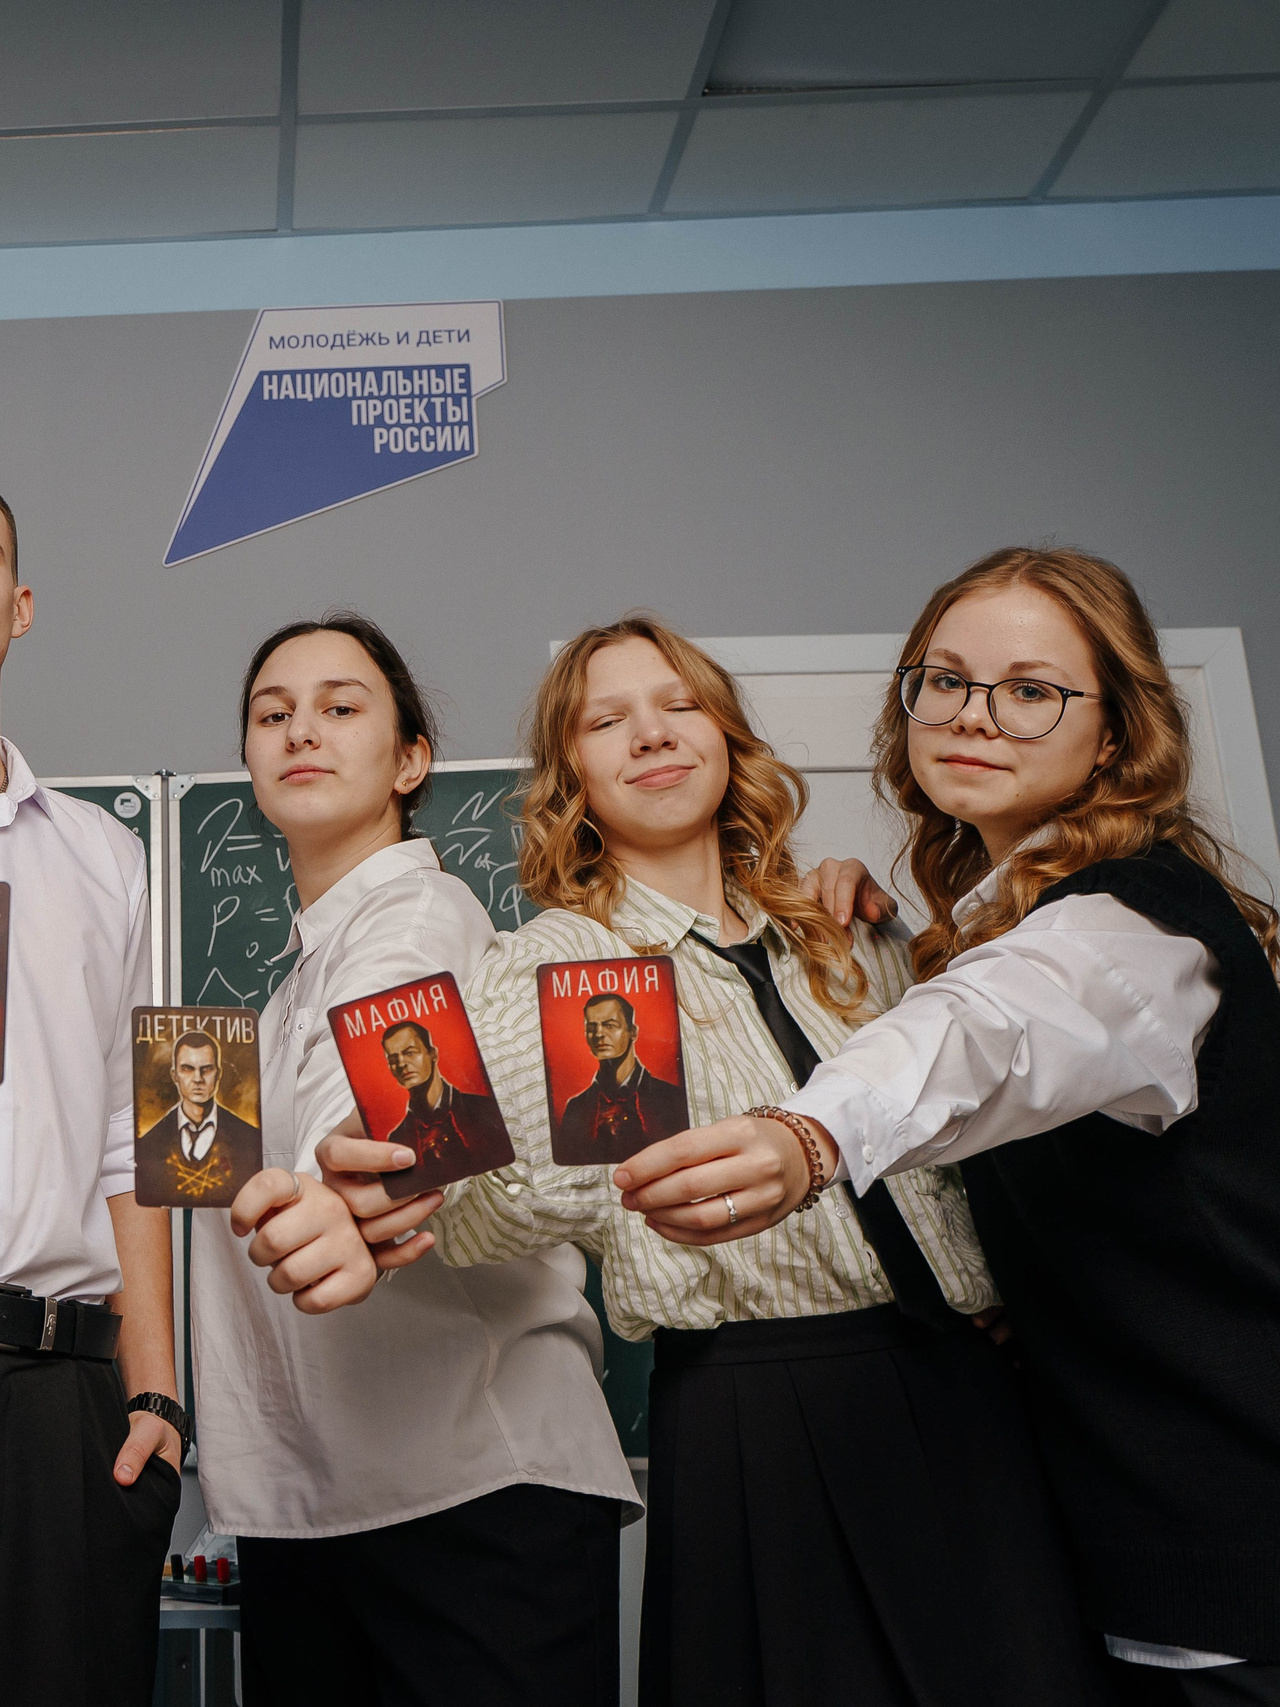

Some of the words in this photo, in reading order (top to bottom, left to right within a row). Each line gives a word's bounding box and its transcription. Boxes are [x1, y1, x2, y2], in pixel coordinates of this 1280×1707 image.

[269, 330, 390, 351] МОЛОДЁЖЬ
[396, 331, 410, 345] И
[416, 329, 471, 347] ДЕТИ
[262, 367, 468, 402] НАЦИОНАЛЬНЫЕ
[351, 396, 469, 426] ПРОЕКТЫ
[373, 425, 471, 454] РОССИИ
[551, 964, 660, 998] МАФИЯ
[342, 983, 449, 1040] МАФИЯ
[135, 1014, 256, 1045] ДЕТЕКТИВ
